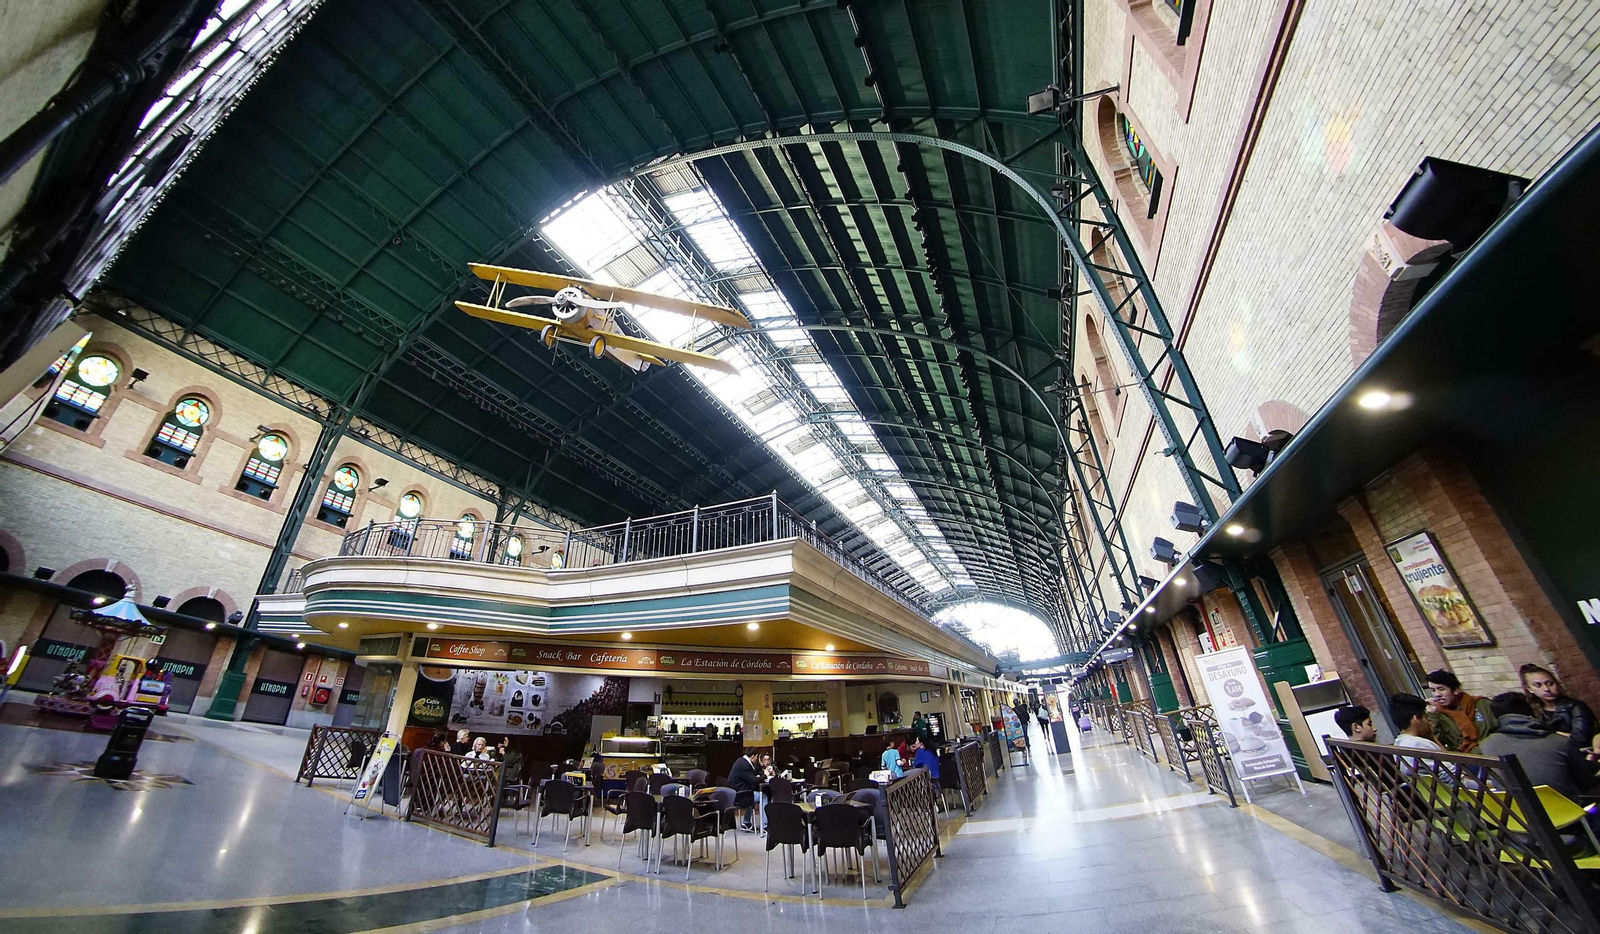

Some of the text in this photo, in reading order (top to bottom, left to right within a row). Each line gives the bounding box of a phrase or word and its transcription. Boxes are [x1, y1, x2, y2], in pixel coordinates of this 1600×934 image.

[1405, 563, 1446, 584] crujiente
[449, 644, 469, 655] Coffee
[469, 645, 486, 656] Shop
[536, 650, 563, 661] Snack
[565, 652, 582, 661] Bar
[590, 653, 628, 664] Cafetería
[681, 658, 692, 666] La
[694, 658, 728, 667] Estación
[730, 659, 739, 667] de
[741, 659, 772, 668] Córdoba
[162, 662, 195, 675] UTHOPIA
[811, 661, 819, 669] La
[821, 661, 845, 669] Estación
[845, 661, 852, 669] de
[852, 661, 873, 670] Córdoba
[1208, 665, 1247, 681] DESAYUNO
[260, 682, 287, 694] UTHOPIA
